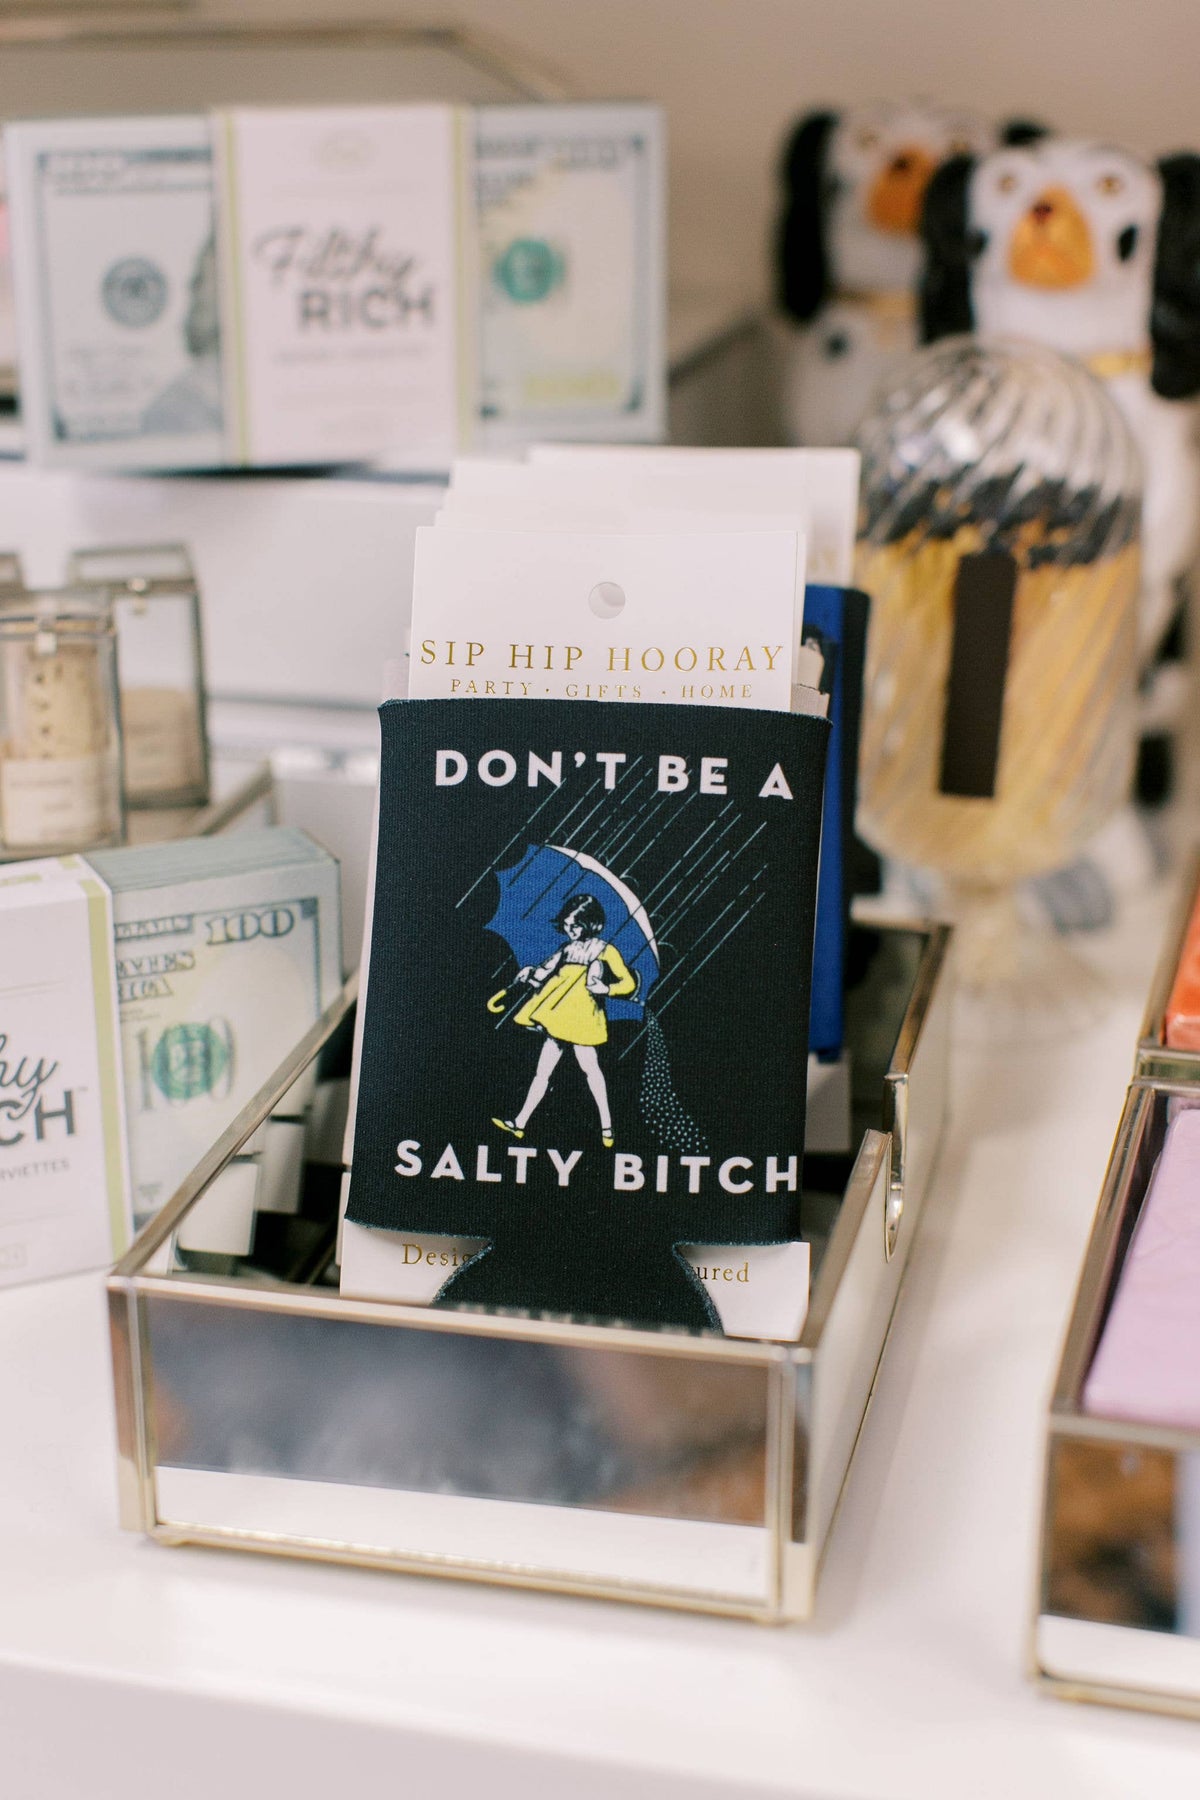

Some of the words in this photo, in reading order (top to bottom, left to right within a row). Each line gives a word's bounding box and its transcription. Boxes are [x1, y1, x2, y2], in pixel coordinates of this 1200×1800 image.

[299, 284, 437, 334] RICH
[421, 639, 485, 665] SIP
[508, 644, 583, 671] HIP
[607, 645, 783, 672] HOORAY
[451, 678, 532, 696] PARTY
[566, 683, 641, 698] GIFTS
[682, 684, 752, 699] HOME
[435, 749, 627, 790] DON'T
[658, 755, 729, 795] BE
[758, 762, 794, 800] A
[206, 907, 294, 946] 100
[394, 1139, 583, 1187] SALTY
[613, 1153, 798, 1194] BITCH
